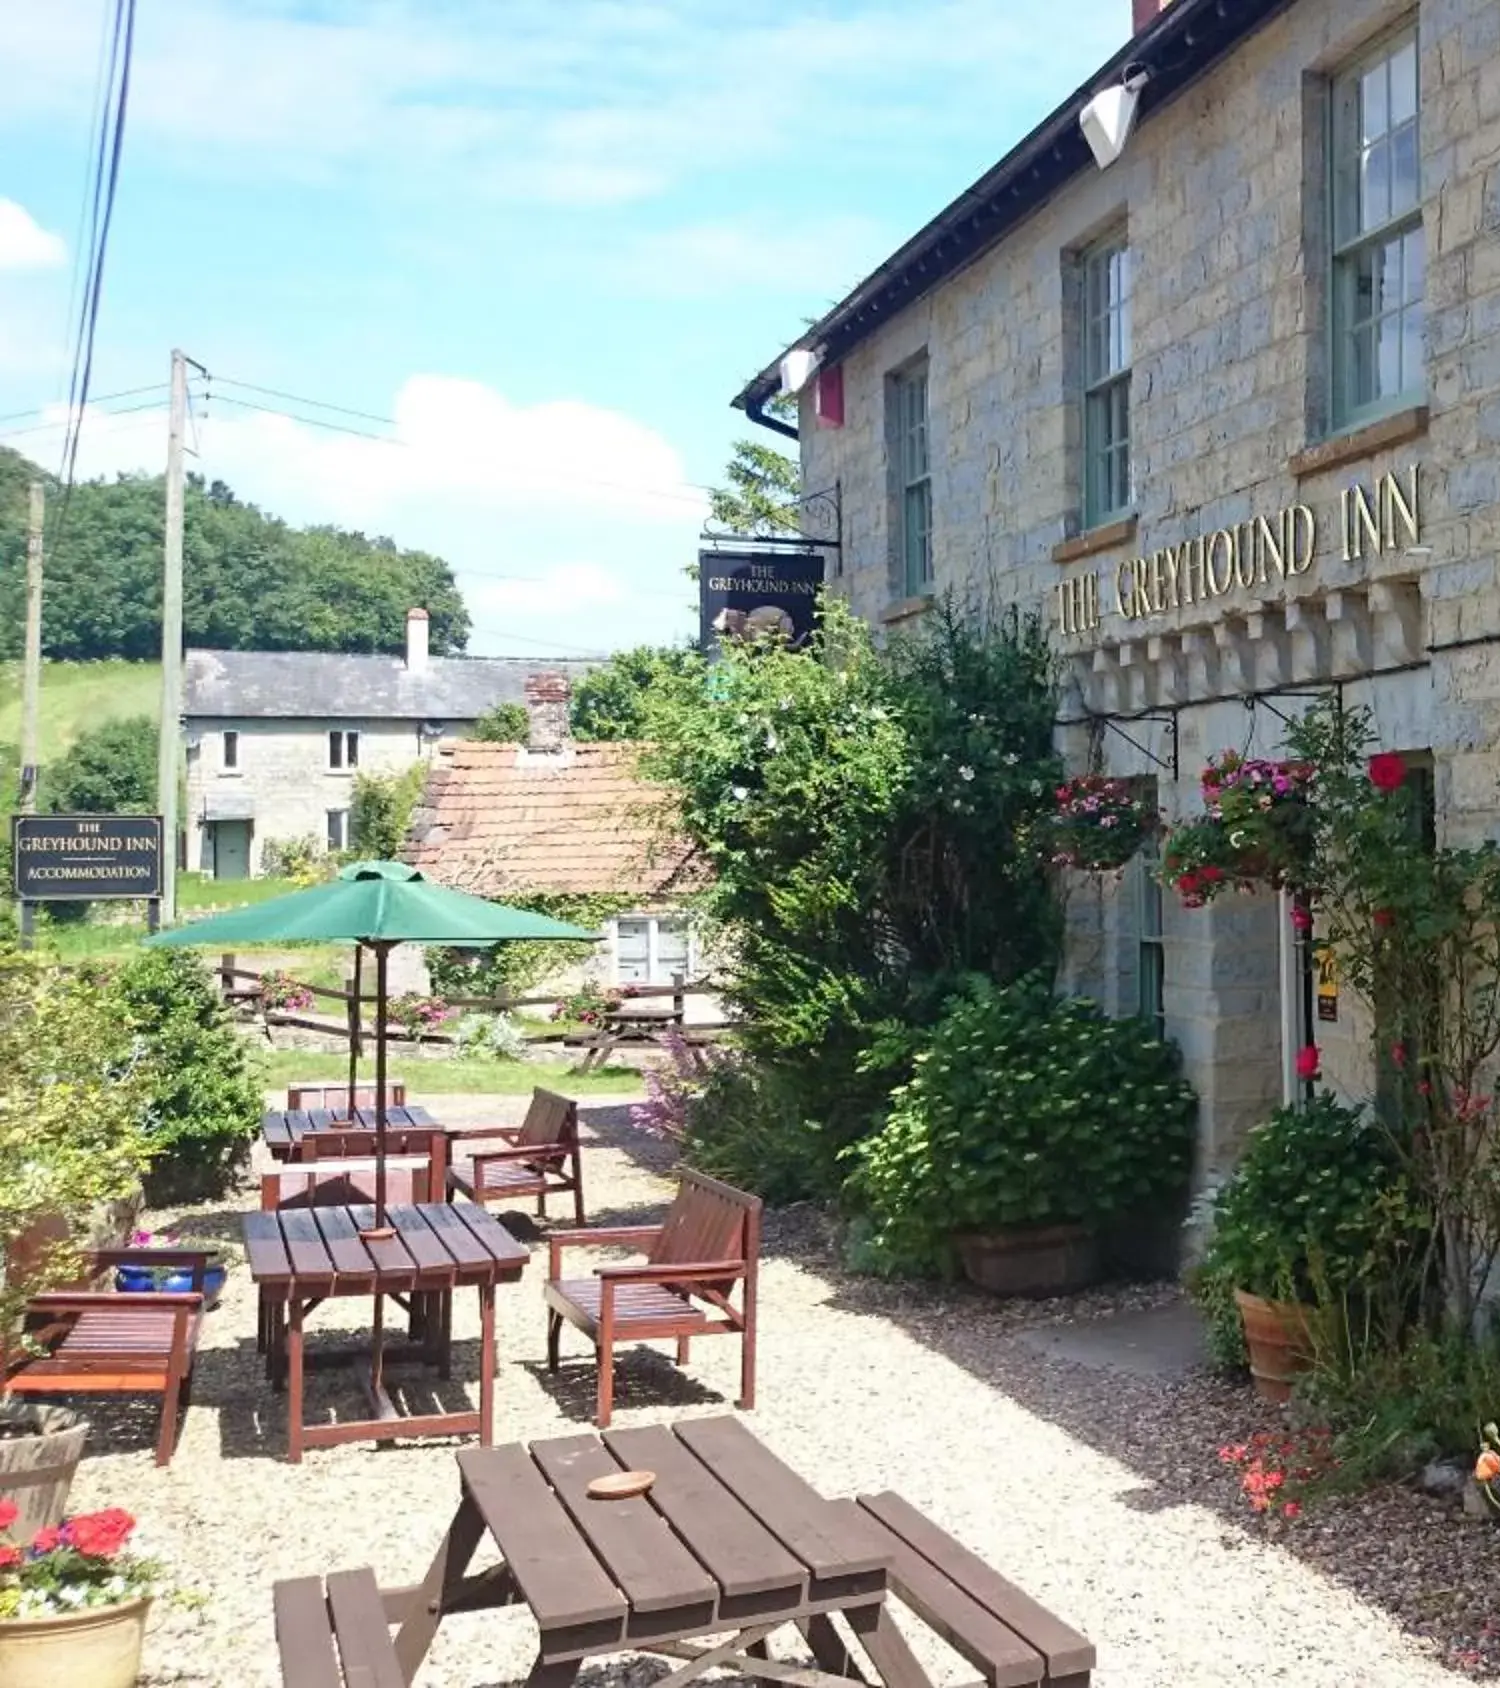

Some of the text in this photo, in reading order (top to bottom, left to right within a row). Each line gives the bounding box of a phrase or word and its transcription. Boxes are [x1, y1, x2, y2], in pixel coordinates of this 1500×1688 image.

[1056, 462, 1420, 636] THE GREYHOUND INN
[751, 564, 775, 578] THE
[709, 577, 789, 593] GREYHOUND
[78, 822, 102, 833] THE
[19, 836, 157, 852] GREYHOUND INN
[27, 866, 151, 881] ACCOMMODATION
